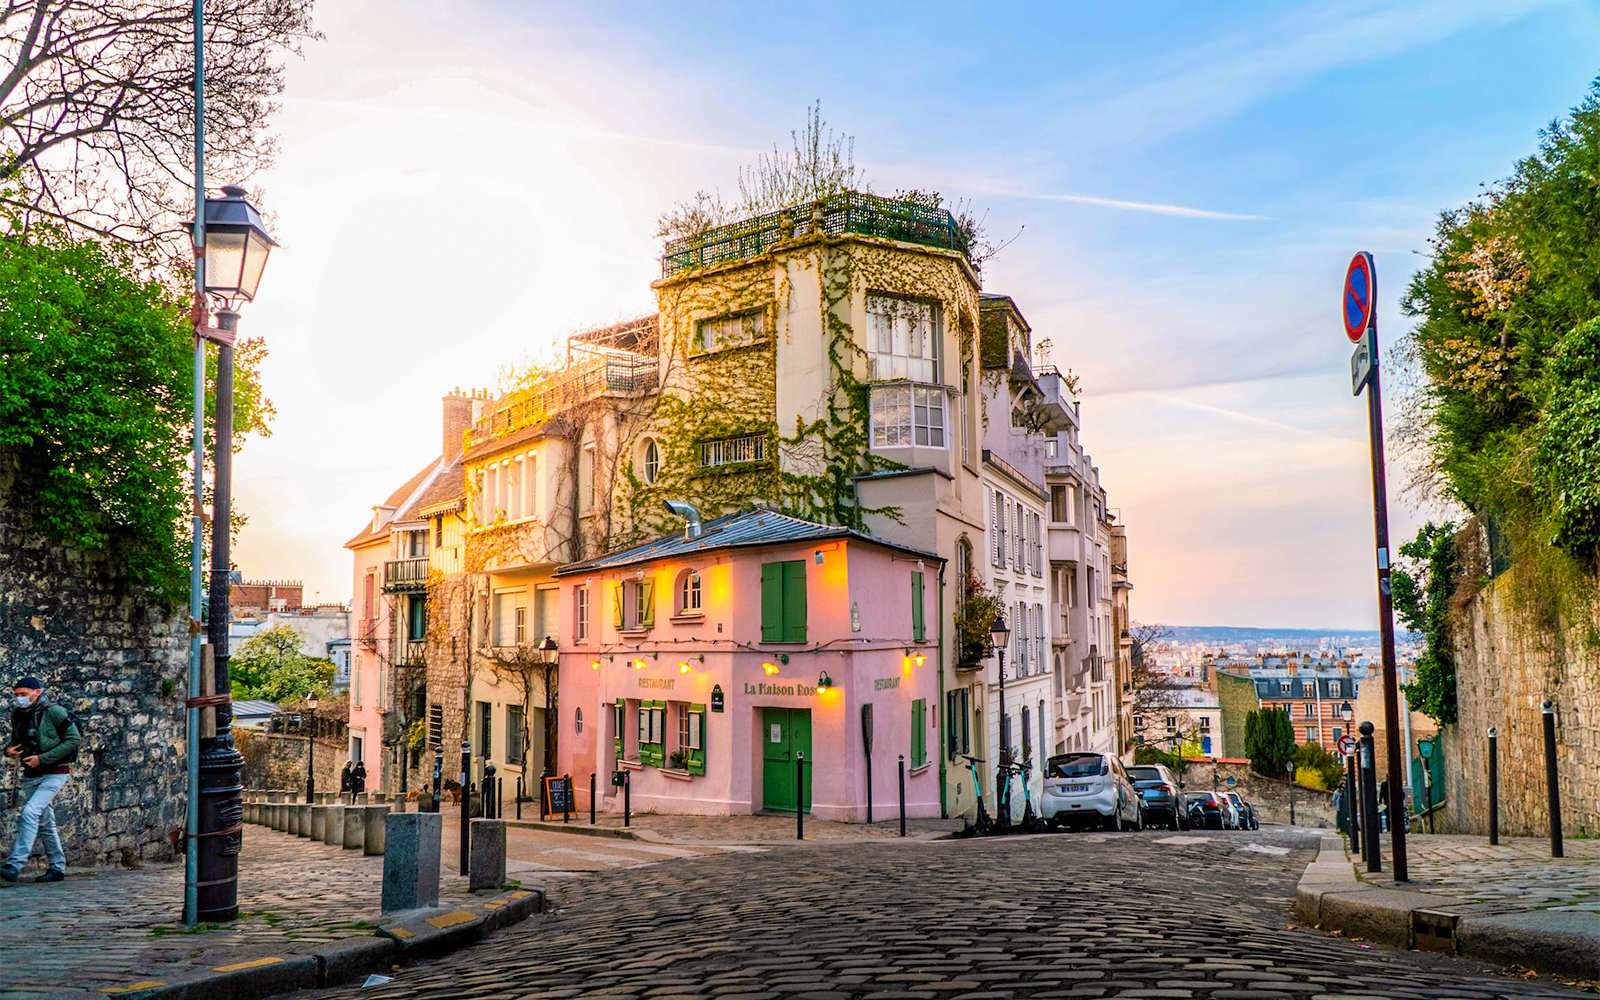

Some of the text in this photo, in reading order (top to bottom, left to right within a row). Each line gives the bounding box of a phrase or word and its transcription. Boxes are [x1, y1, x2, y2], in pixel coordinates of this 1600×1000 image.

[638, 678, 676, 690] RESTAURANT
[744, 683, 756, 695] La
[759, 683, 794, 696] Maison
